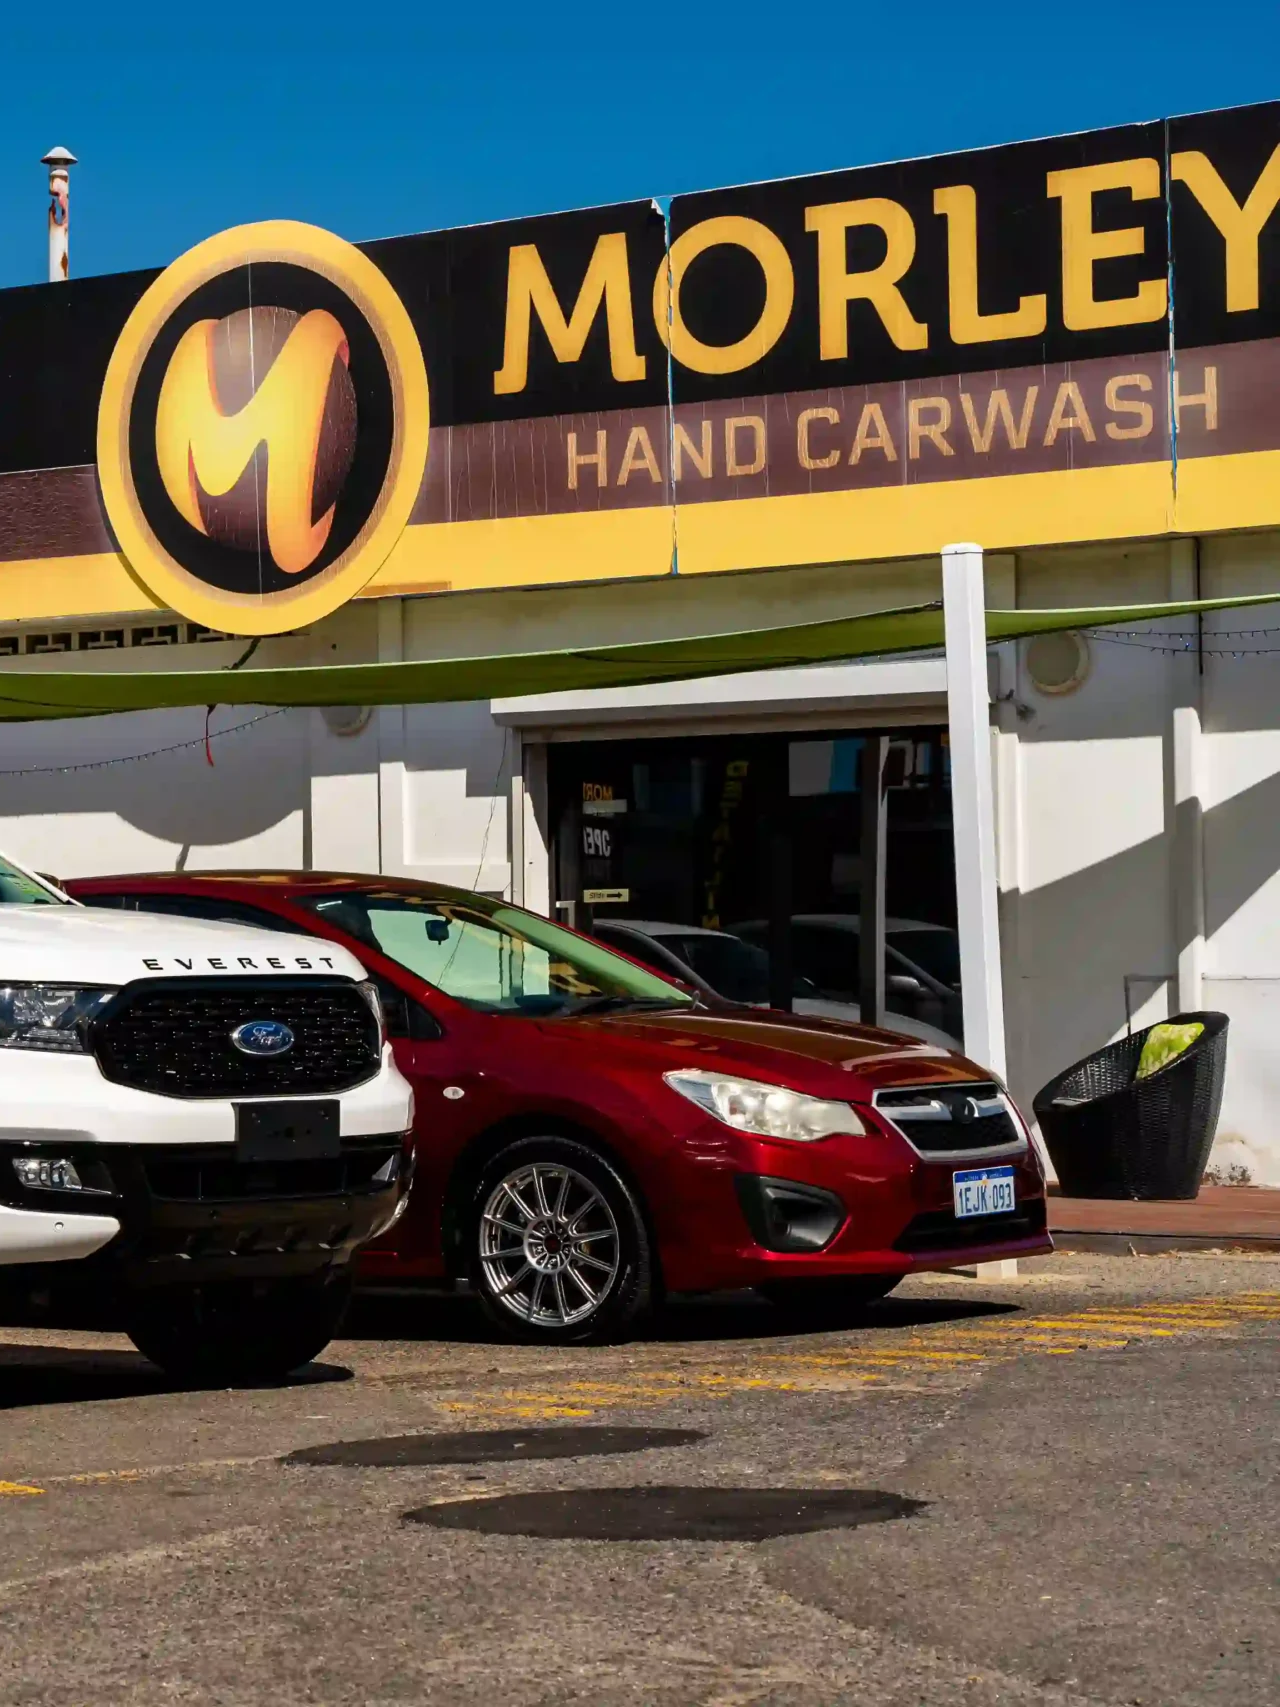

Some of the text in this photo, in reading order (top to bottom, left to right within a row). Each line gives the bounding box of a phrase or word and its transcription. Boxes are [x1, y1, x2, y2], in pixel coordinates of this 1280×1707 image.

[493, 142, 1280, 395] MORLEY
[566, 366, 1220, 490] HAND CARWASH
[142, 957, 335, 971] EVEREST
